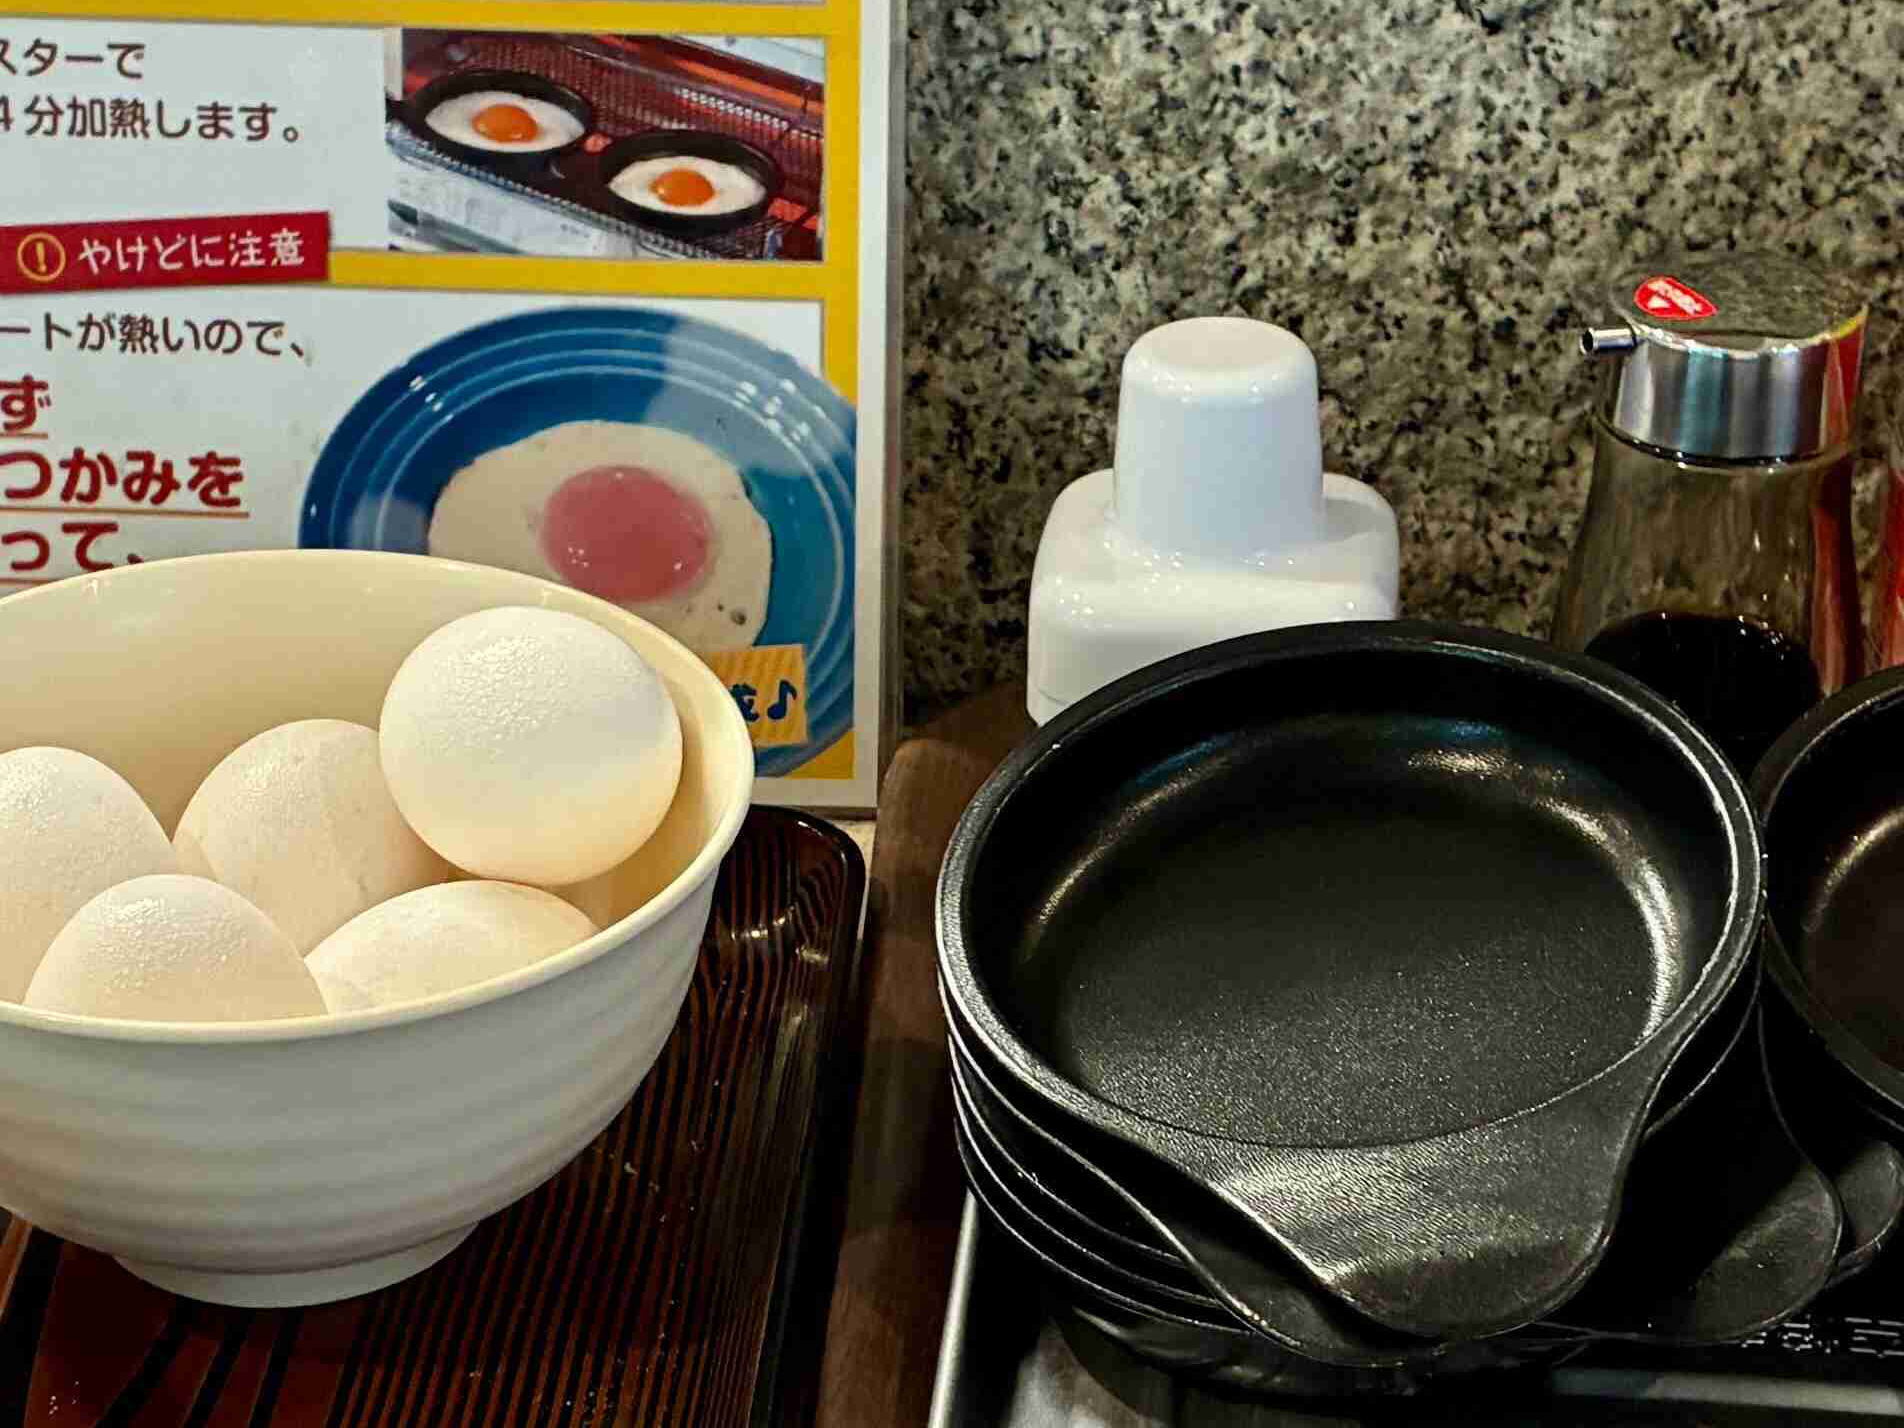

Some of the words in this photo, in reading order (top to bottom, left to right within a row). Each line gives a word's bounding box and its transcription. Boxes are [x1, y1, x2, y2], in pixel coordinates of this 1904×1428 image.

[79, 227, 306, 275] やけどに注意
